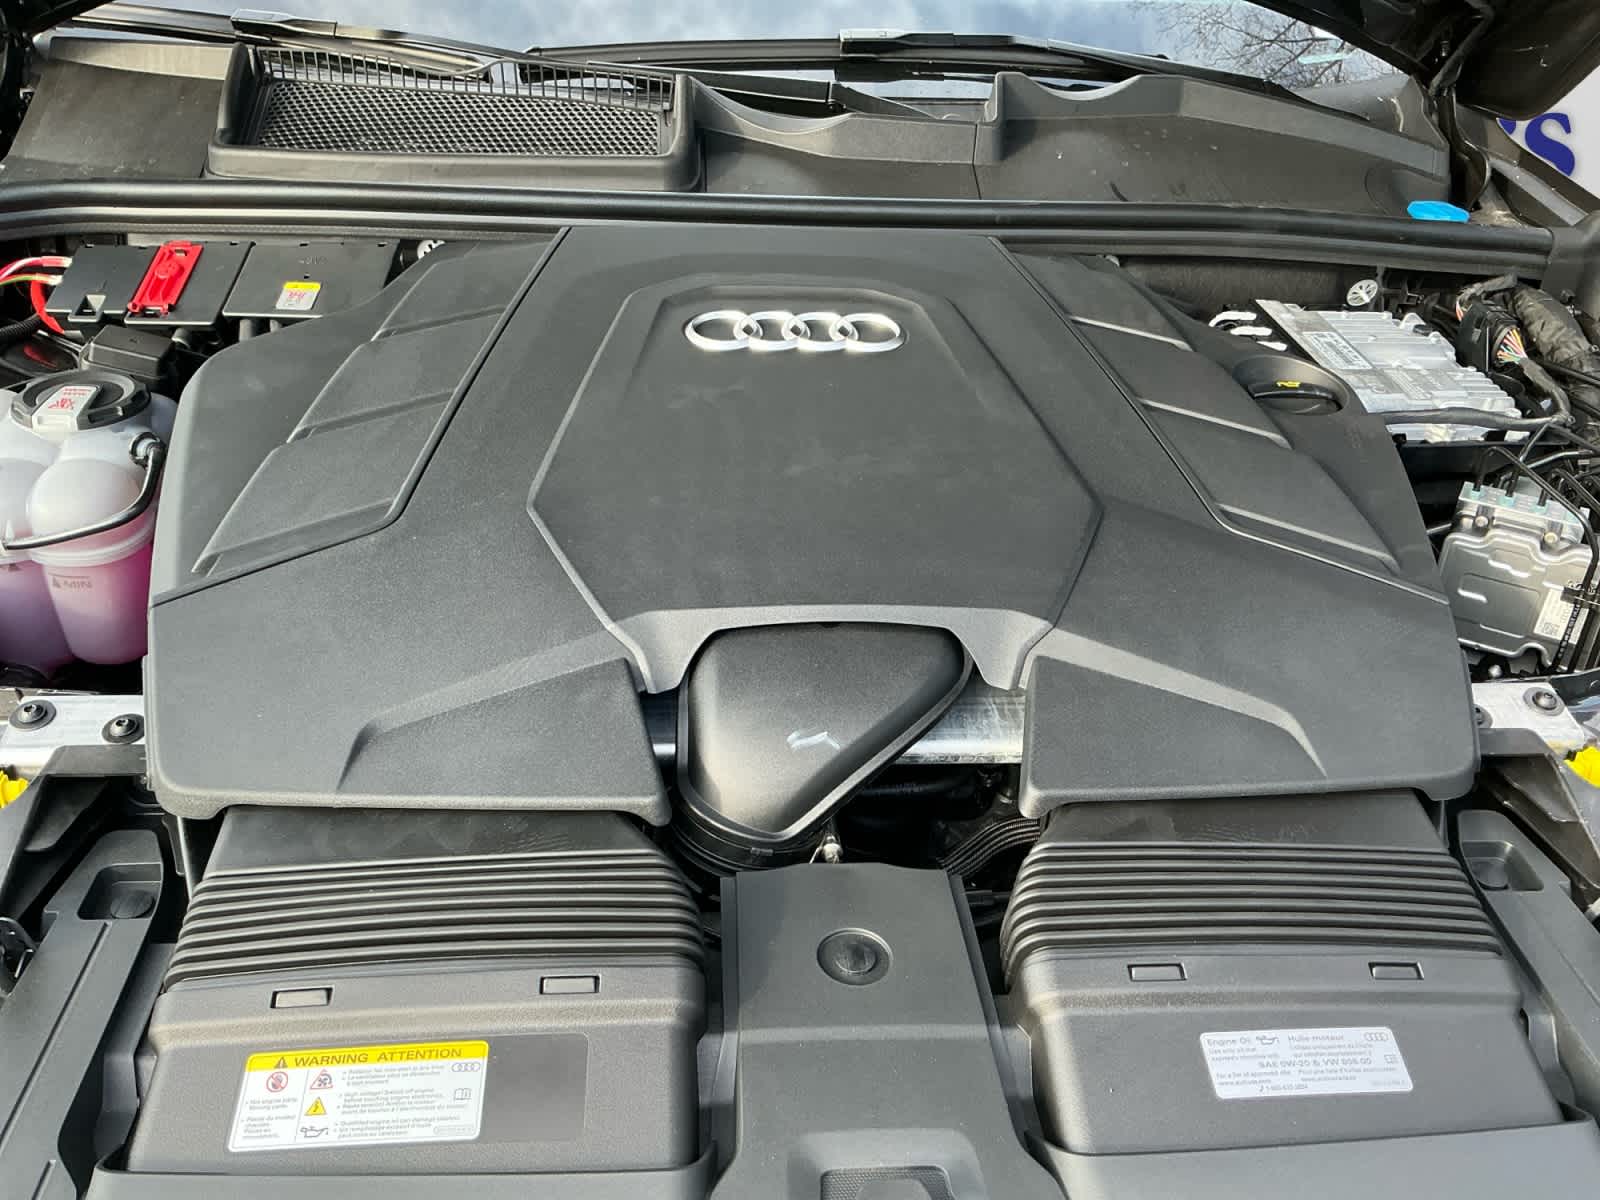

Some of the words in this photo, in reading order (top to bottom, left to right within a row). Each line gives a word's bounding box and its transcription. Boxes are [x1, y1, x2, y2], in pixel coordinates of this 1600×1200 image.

[1207, 1039, 1237, 1047] Engine
[294, 1053, 369, 1067] WARNING
[377, 1048, 462, 1062] ATTENTION
